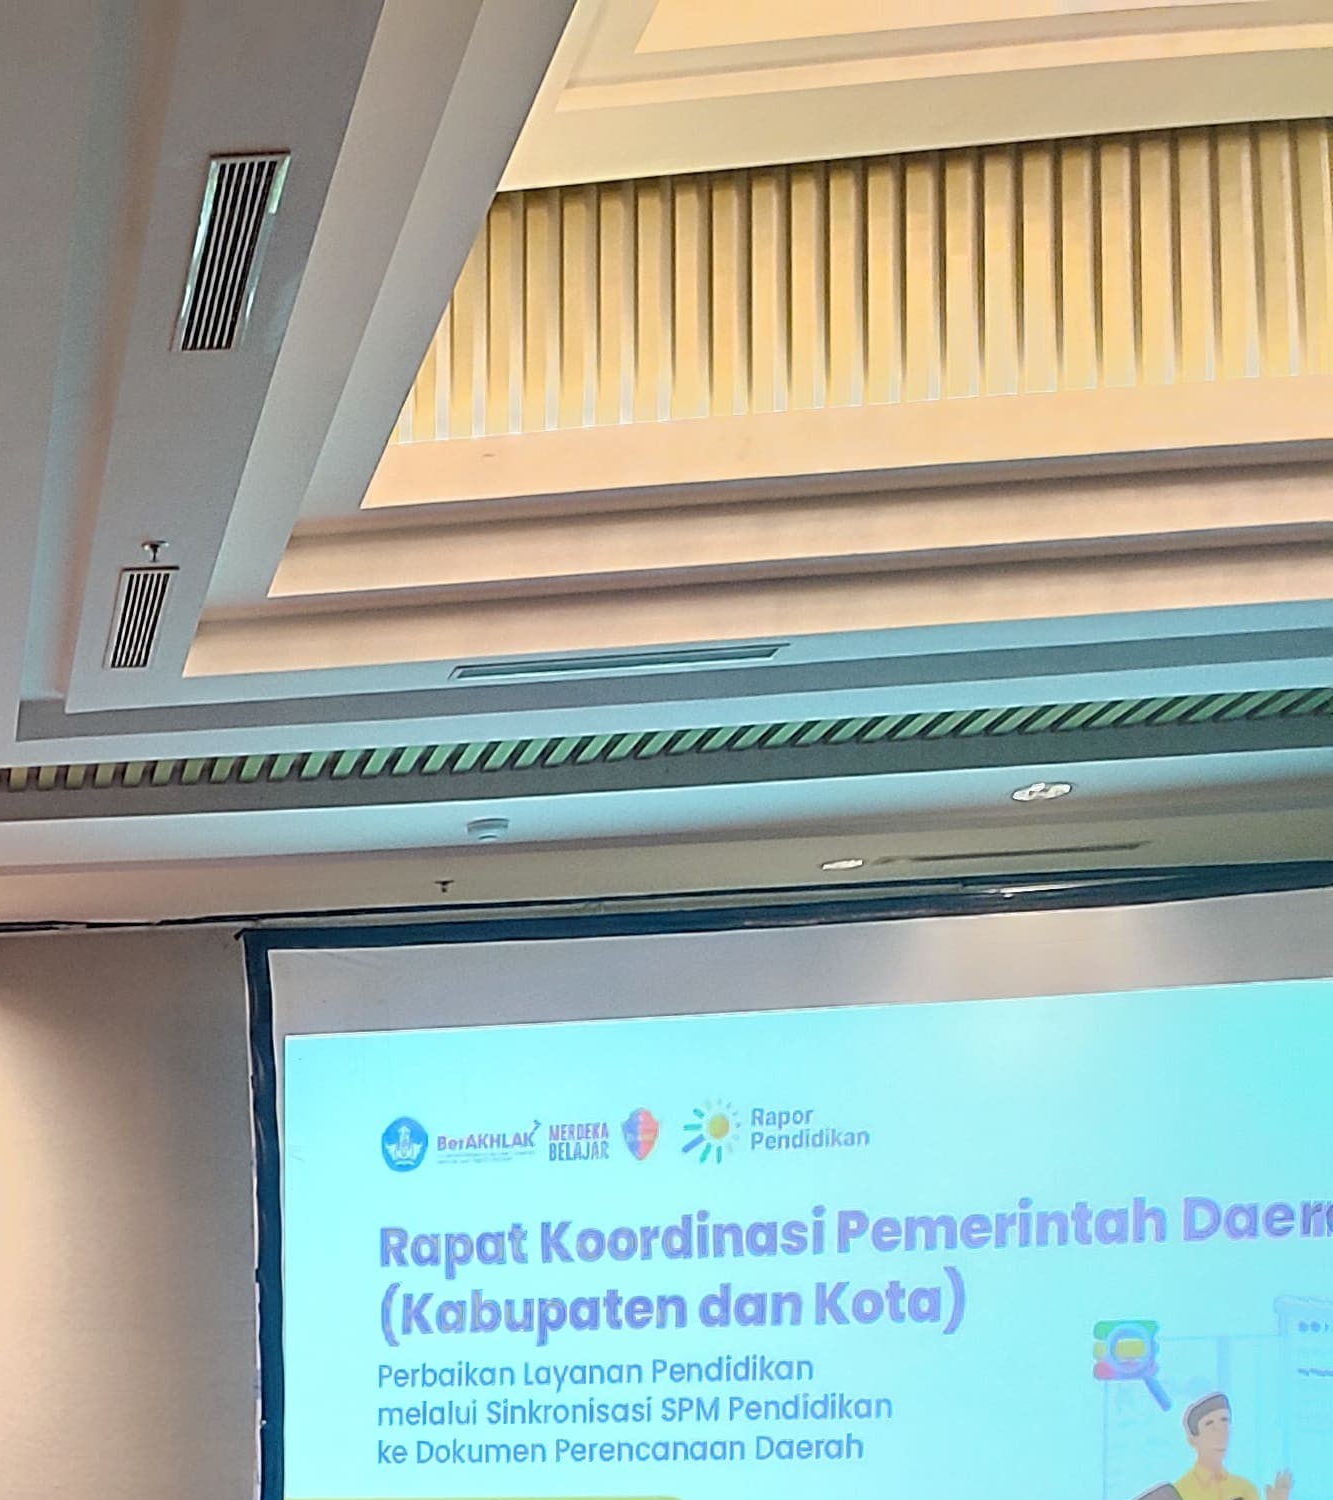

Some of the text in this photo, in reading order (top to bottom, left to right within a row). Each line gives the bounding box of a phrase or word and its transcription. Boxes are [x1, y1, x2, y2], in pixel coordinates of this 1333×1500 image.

[548, 1122, 610, 1142] MERDEKA
[750, 1107, 814, 1131] Rapor
[436, 1131, 535, 1152] BerAKHLAK
[548, 1141, 610, 1162] BELAJAR
[750, 1127, 871, 1150] Pendidikan
[379, 1195, 1333, 1280] Rapat Koordinasi Pemerintah Daer
[380, 1264, 966, 1347] (Kabupaten dan Kota)
[377, 1355, 815, 1394] Perbaikan Layanan Pendidikan
[377, 1393, 893, 1426] melalui Sinkronisasi SPM Pendidikan
[377, 1433, 865, 1466] ke Dokumen Perencanaan Daerah
